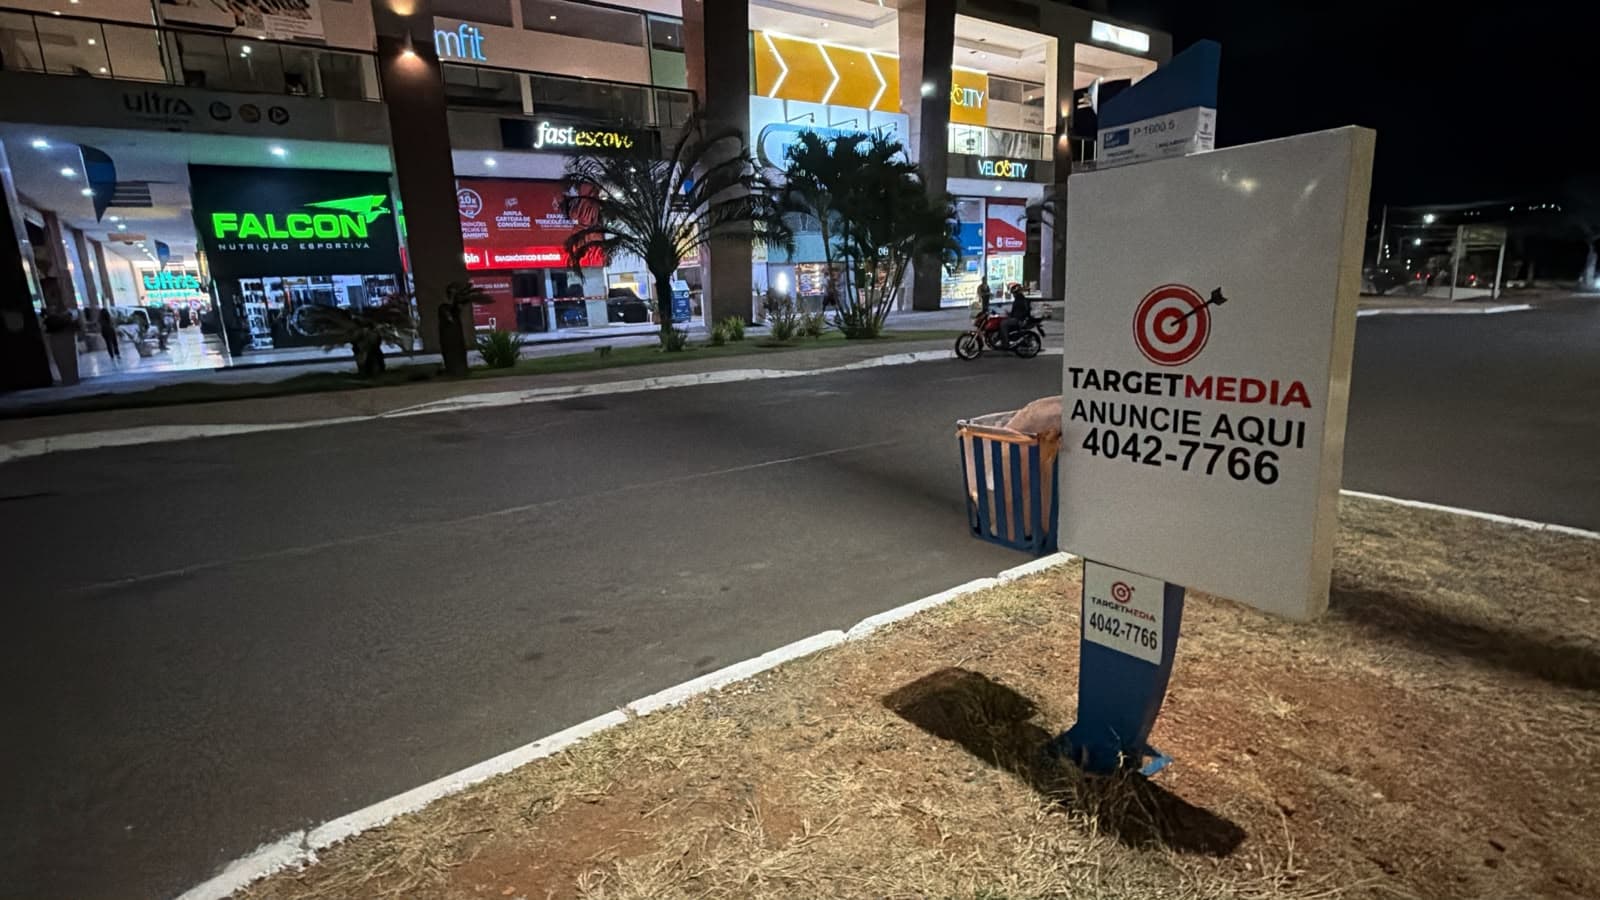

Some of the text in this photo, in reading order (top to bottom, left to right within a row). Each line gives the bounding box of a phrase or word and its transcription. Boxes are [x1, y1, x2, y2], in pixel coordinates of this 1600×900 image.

[434, 23, 487, 60] mfit
[123, 91, 194, 116] ultra
[951, 84, 984, 109] CITY
[978, 160, 1028, 178] VELOCITY
[212, 213, 368, 239] FALCON
[218, 241, 371, 252] NUTRIÇÃO ESPORTIVA
[143, 271, 200, 290] ultra
[1068, 367, 1312, 409] TARGETMEDIA
[1070, 398, 1306, 449] ANUNCIE AQUI
[1082, 427, 1280, 485] 4042-7766
[1091, 596, 1156, 622] TARGETMEDIA
[1089, 611, 1157, 650] 4042-7766
